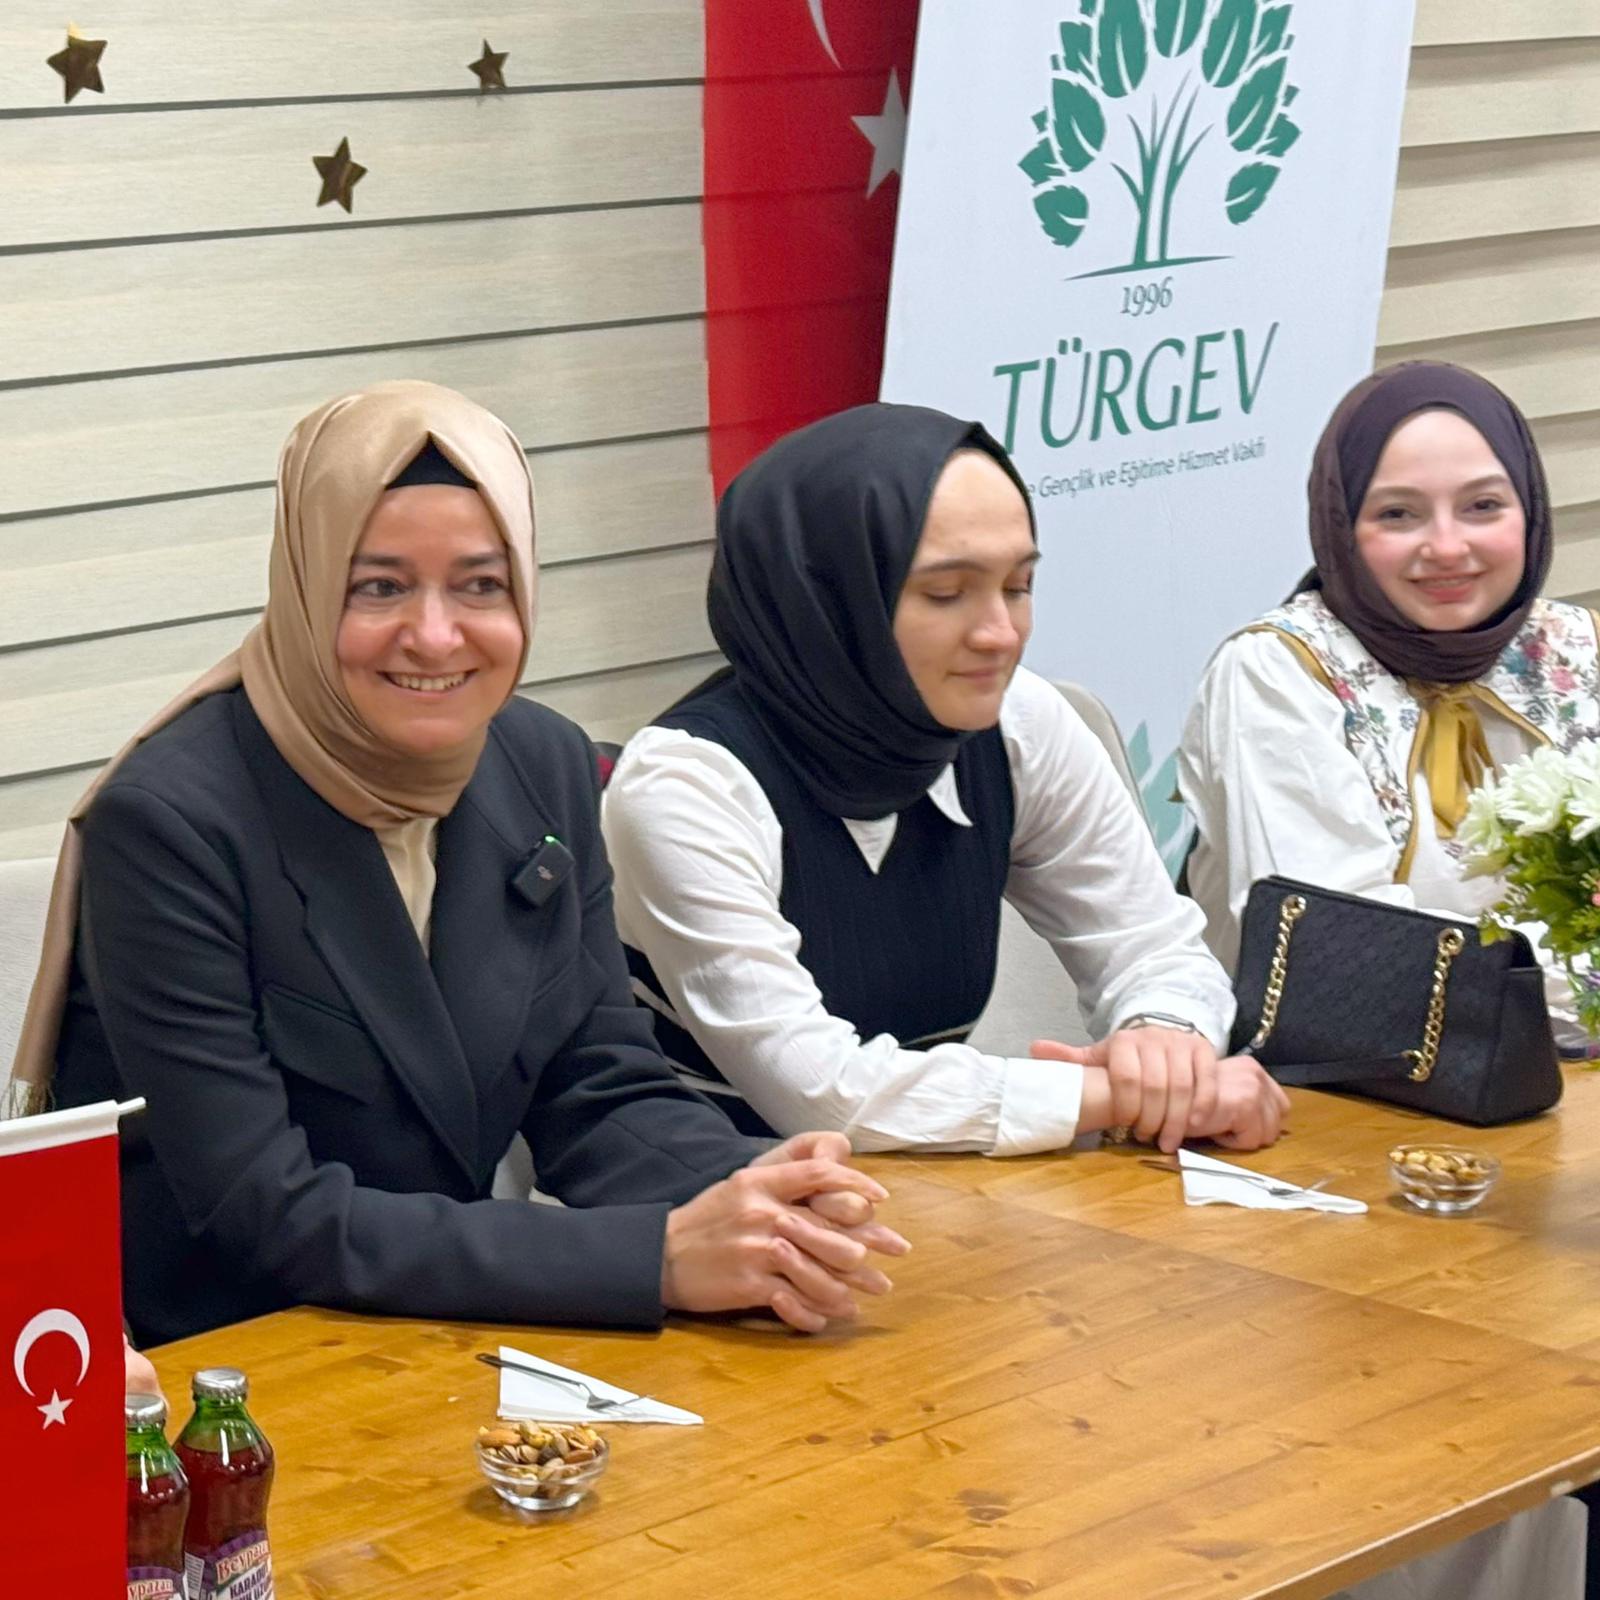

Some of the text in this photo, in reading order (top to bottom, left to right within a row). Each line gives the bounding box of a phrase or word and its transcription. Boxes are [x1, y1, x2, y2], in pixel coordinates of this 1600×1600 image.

[1120, 275, 1174, 317] 1996
[993, 321, 1280, 455] TÜRGEV
[1039, 469, 1095, 498] Gençlik
[1098, 469, 1117, 487] ve
[1119, 457, 1175, 488] Eğitime
[1177, 446, 1230, 473] Hizmet
